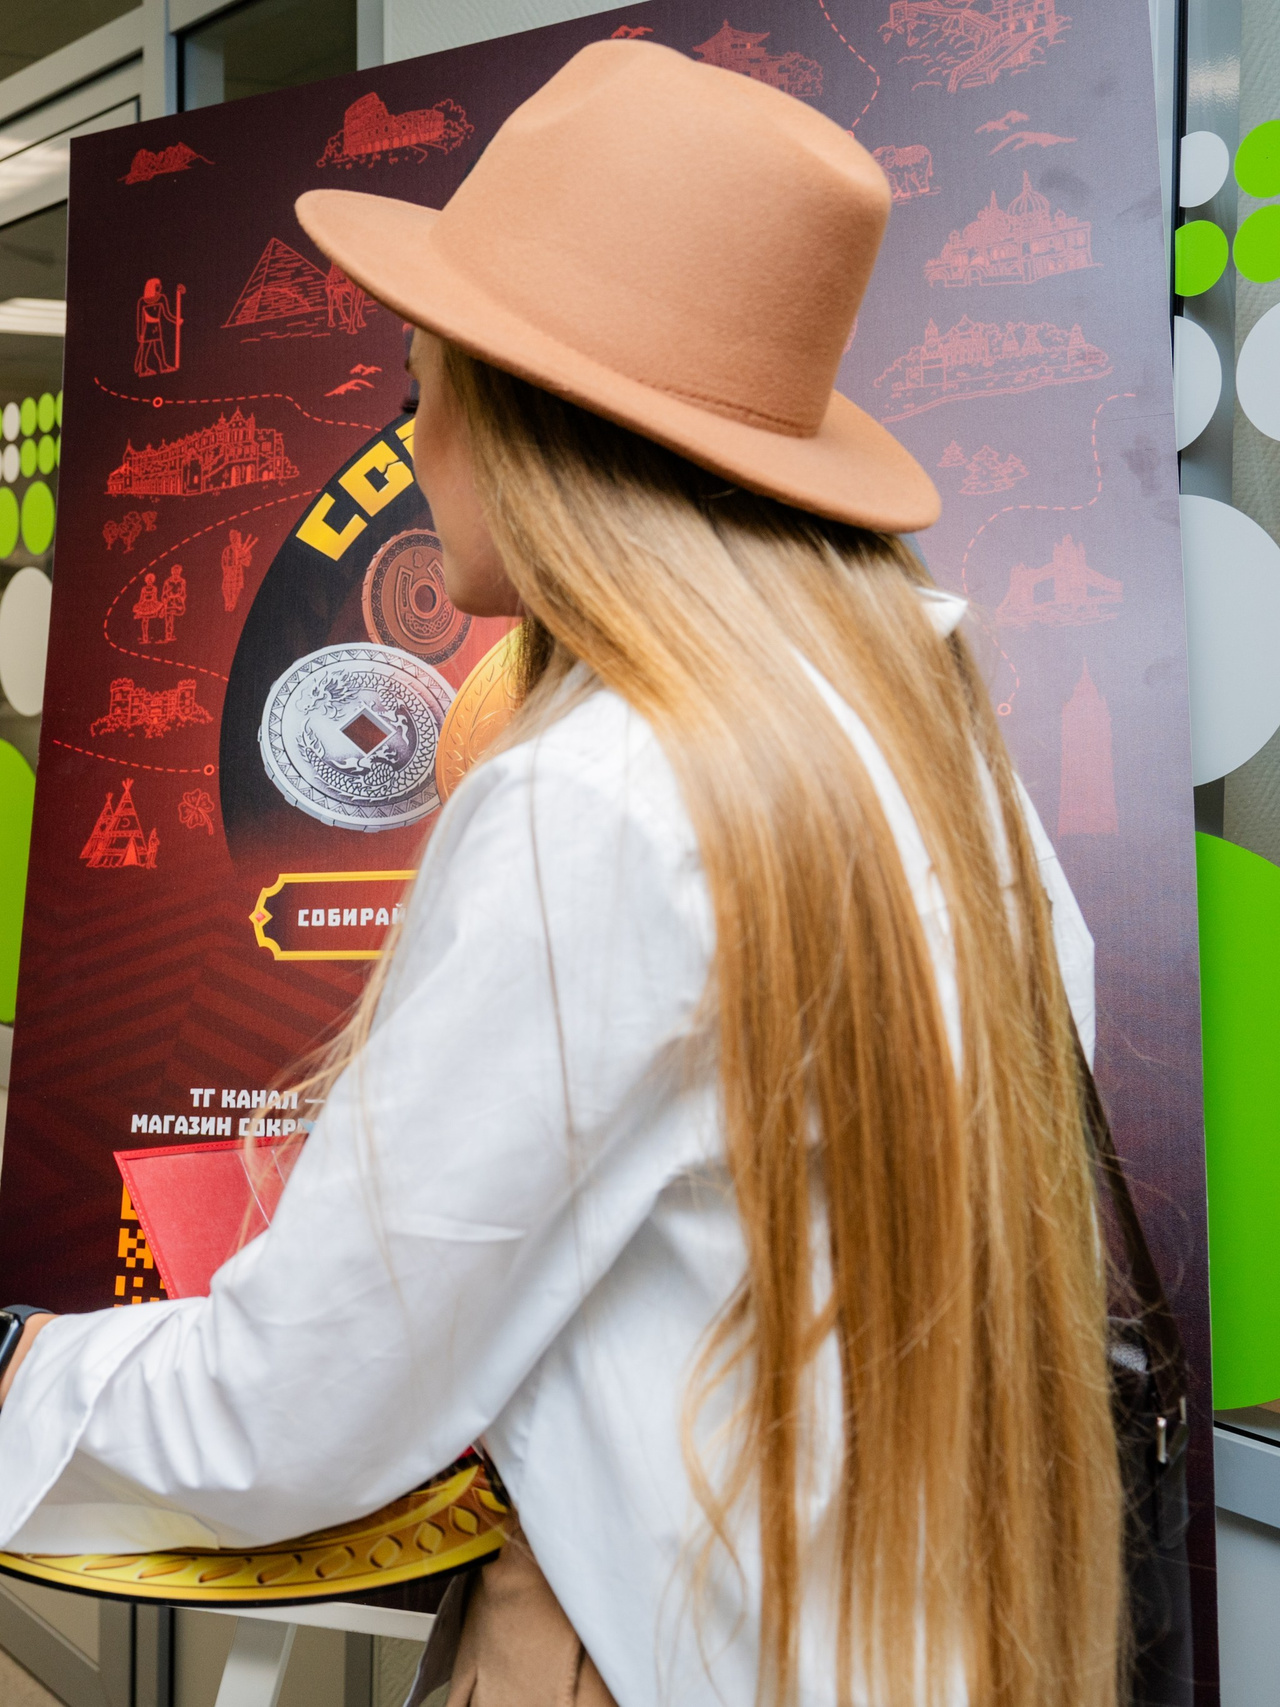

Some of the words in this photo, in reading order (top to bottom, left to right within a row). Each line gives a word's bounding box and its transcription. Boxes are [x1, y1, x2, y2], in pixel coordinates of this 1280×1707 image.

[190, 1088, 216, 1108] ТГ
[221, 1089, 299, 1110] КАНАЛ
[131, 1114, 232, 1137] МАГАЗИН
[238, 1117, 307, 1138] СОКР
